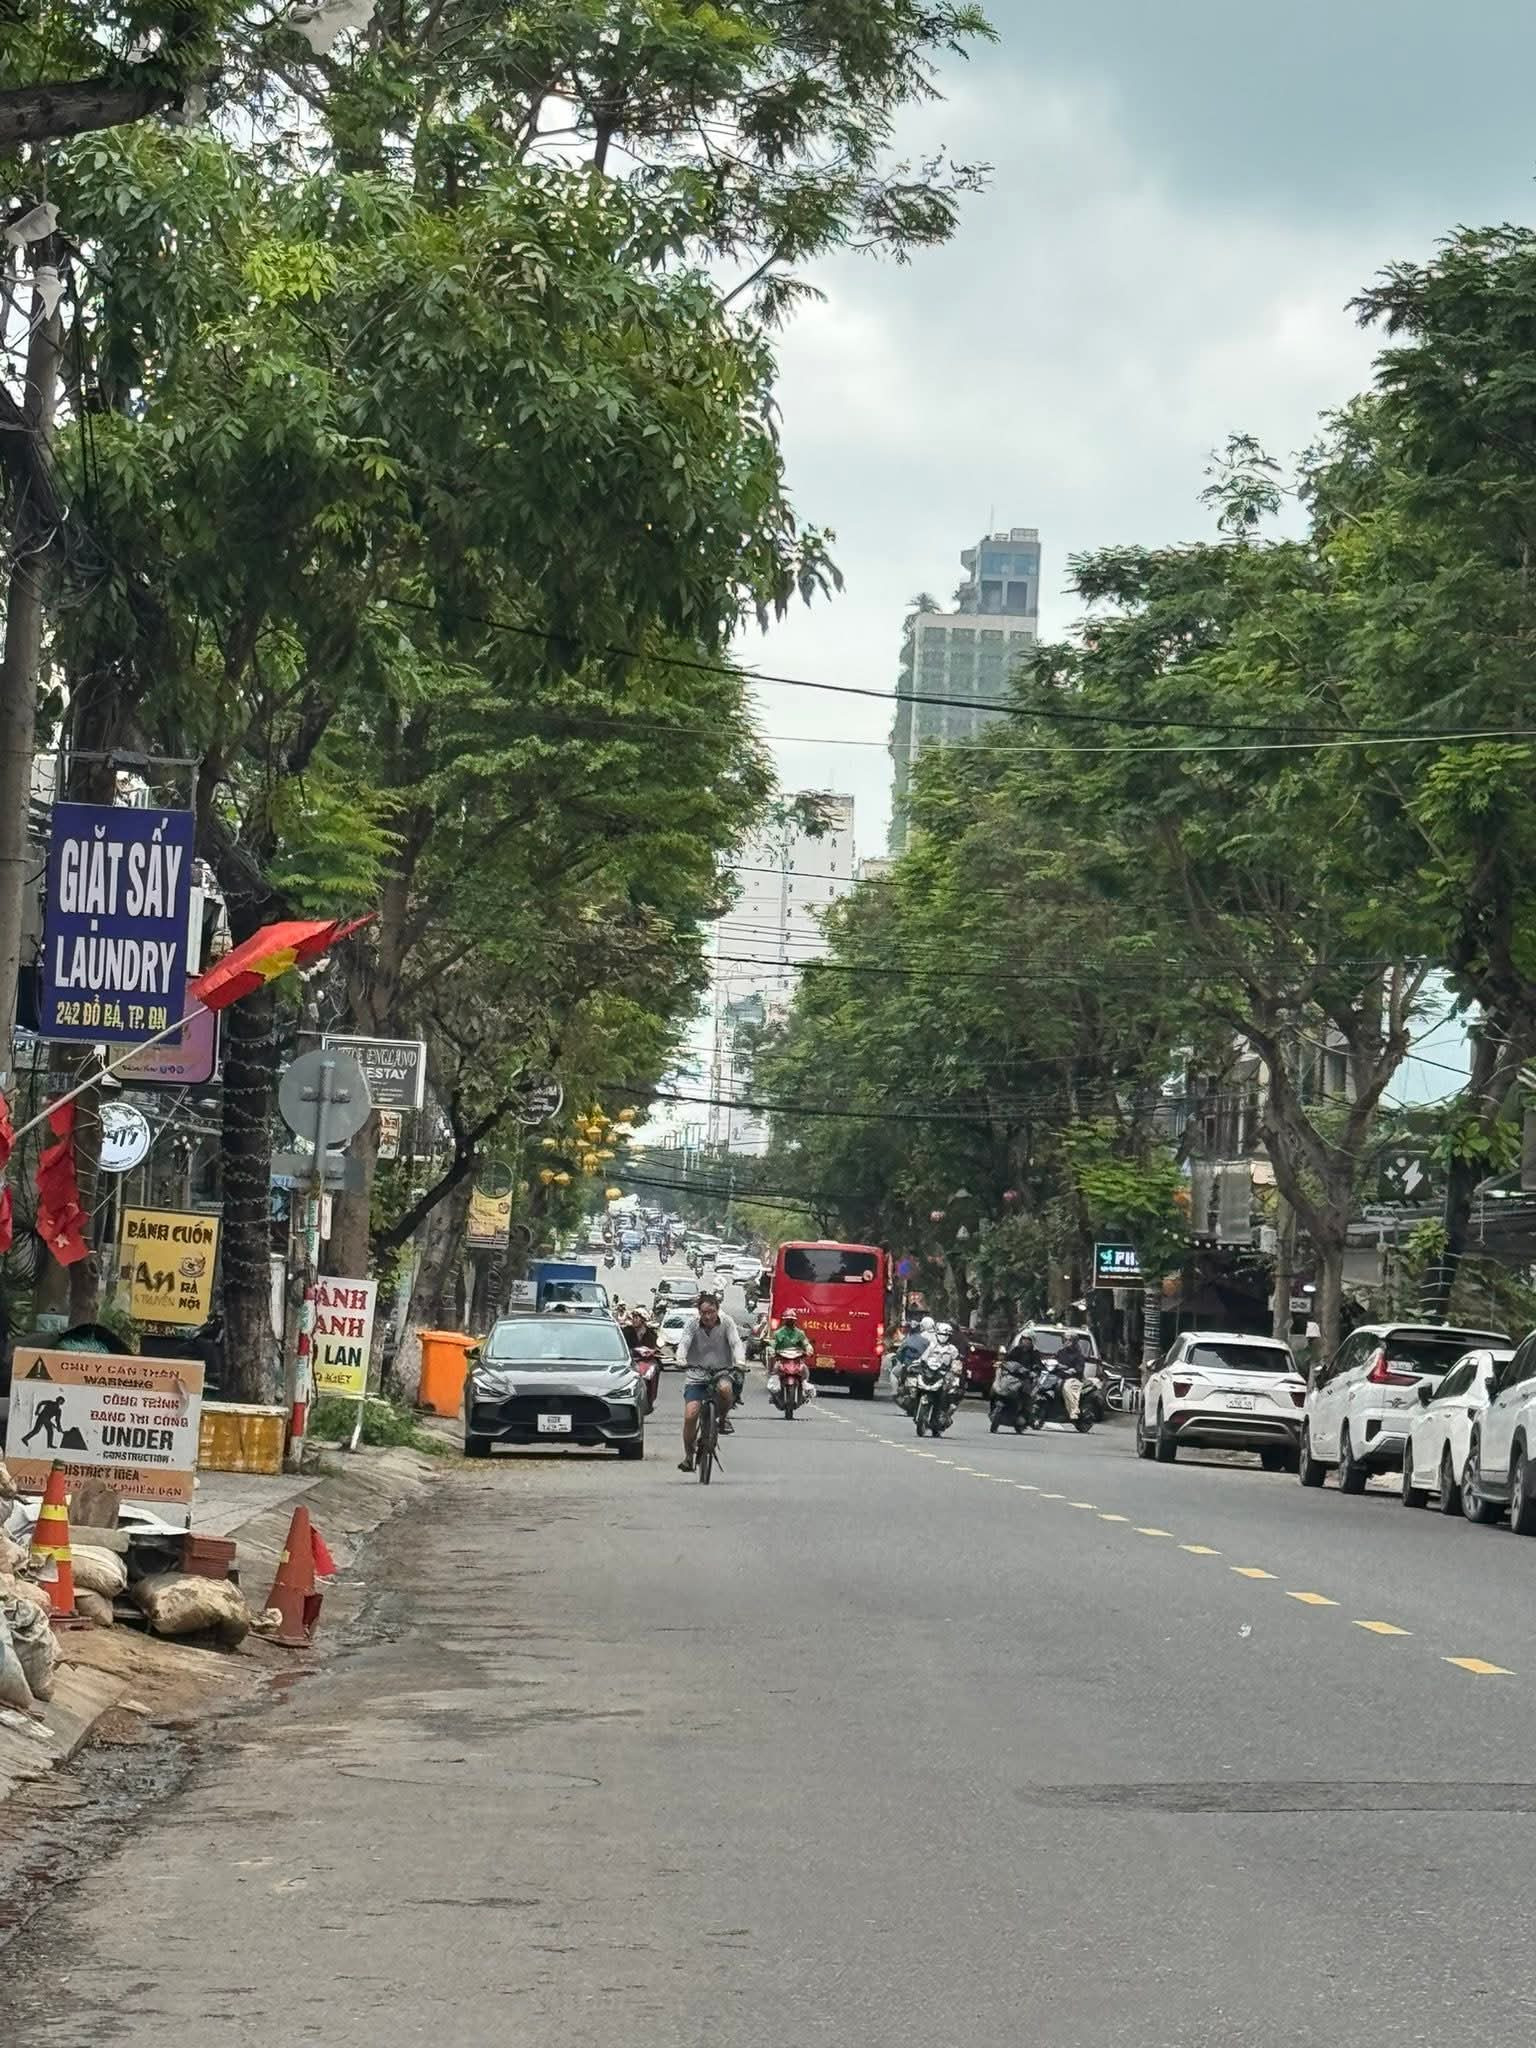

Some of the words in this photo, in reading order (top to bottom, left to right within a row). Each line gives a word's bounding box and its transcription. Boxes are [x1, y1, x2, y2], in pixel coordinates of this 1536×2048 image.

[126, 818, 183, 918] SẤY
[55, 935, 177, 994] LAUNDRY
[55, 1001, 80, 1025] 242
[366, 1066, 408, 1080] ESTAY
[325, 1344, 362, 1367] LAN
[102, 1425, 174, 1450] UNDER
[103, 1451, 170, 1463] CONSTRUCTION
